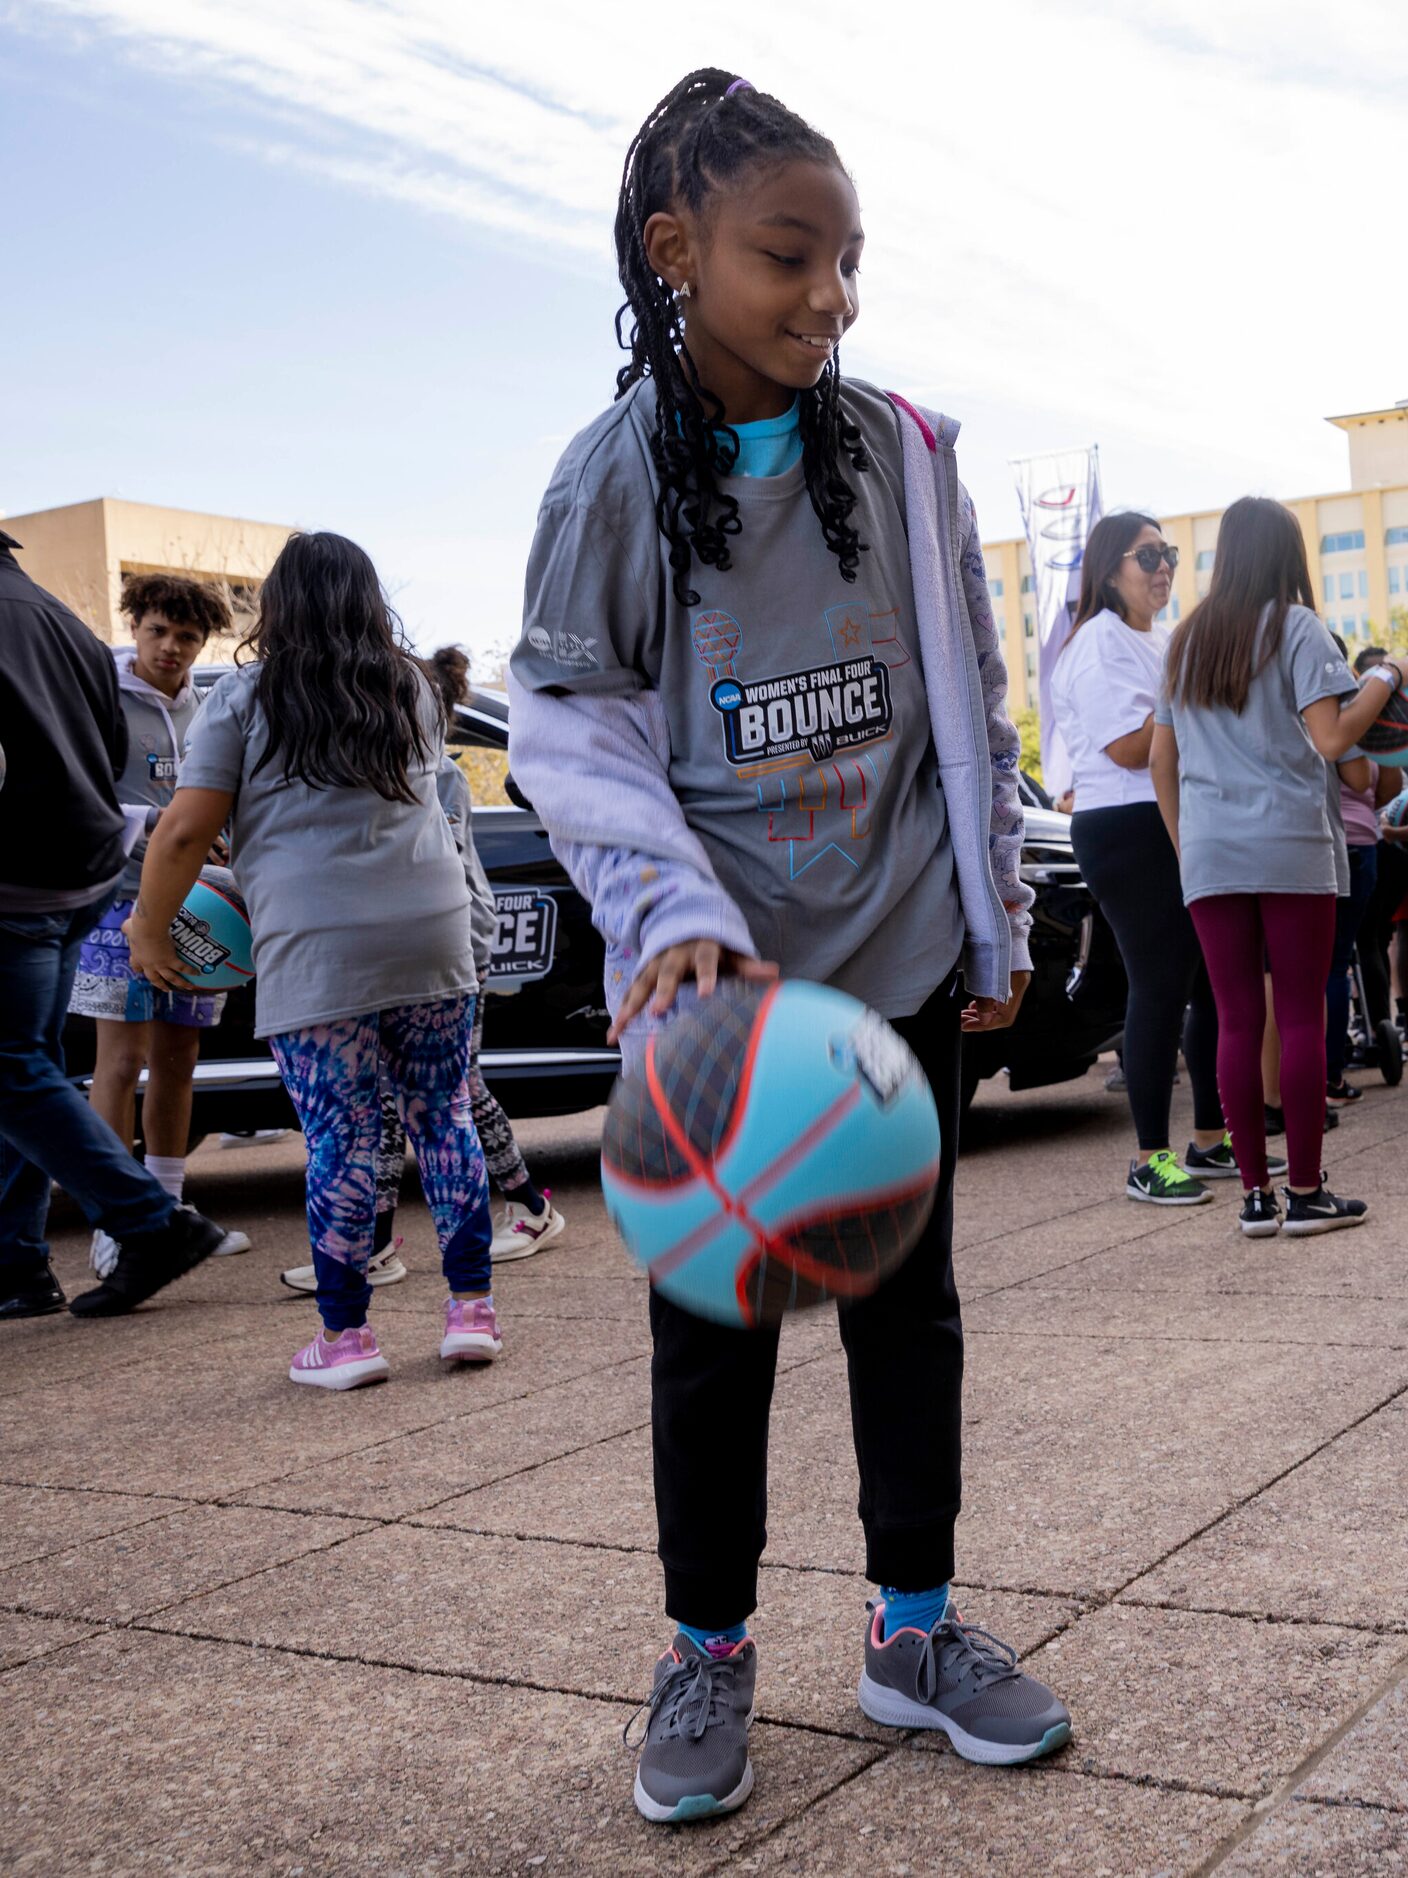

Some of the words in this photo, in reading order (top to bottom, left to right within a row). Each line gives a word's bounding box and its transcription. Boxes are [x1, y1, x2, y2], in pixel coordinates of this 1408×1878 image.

[745, 677, 807, 704] WOMEN'S
[810, 669, 843, 690] FINAL
[845, 661, 872, 681] FOUR
[718, 693, 741, 705] NCAA
[740, 676, 882, 750] BOUNCE
[836, 724, 887, 746] BUICK
[766, 740, 800, 755] PRESENTED
[800, 738, 809, 750] BY
[497, 895, 532, 911] FOUR
[178, 907, 198, 926] BUIC
[490, 960, 544, 973] UICK
